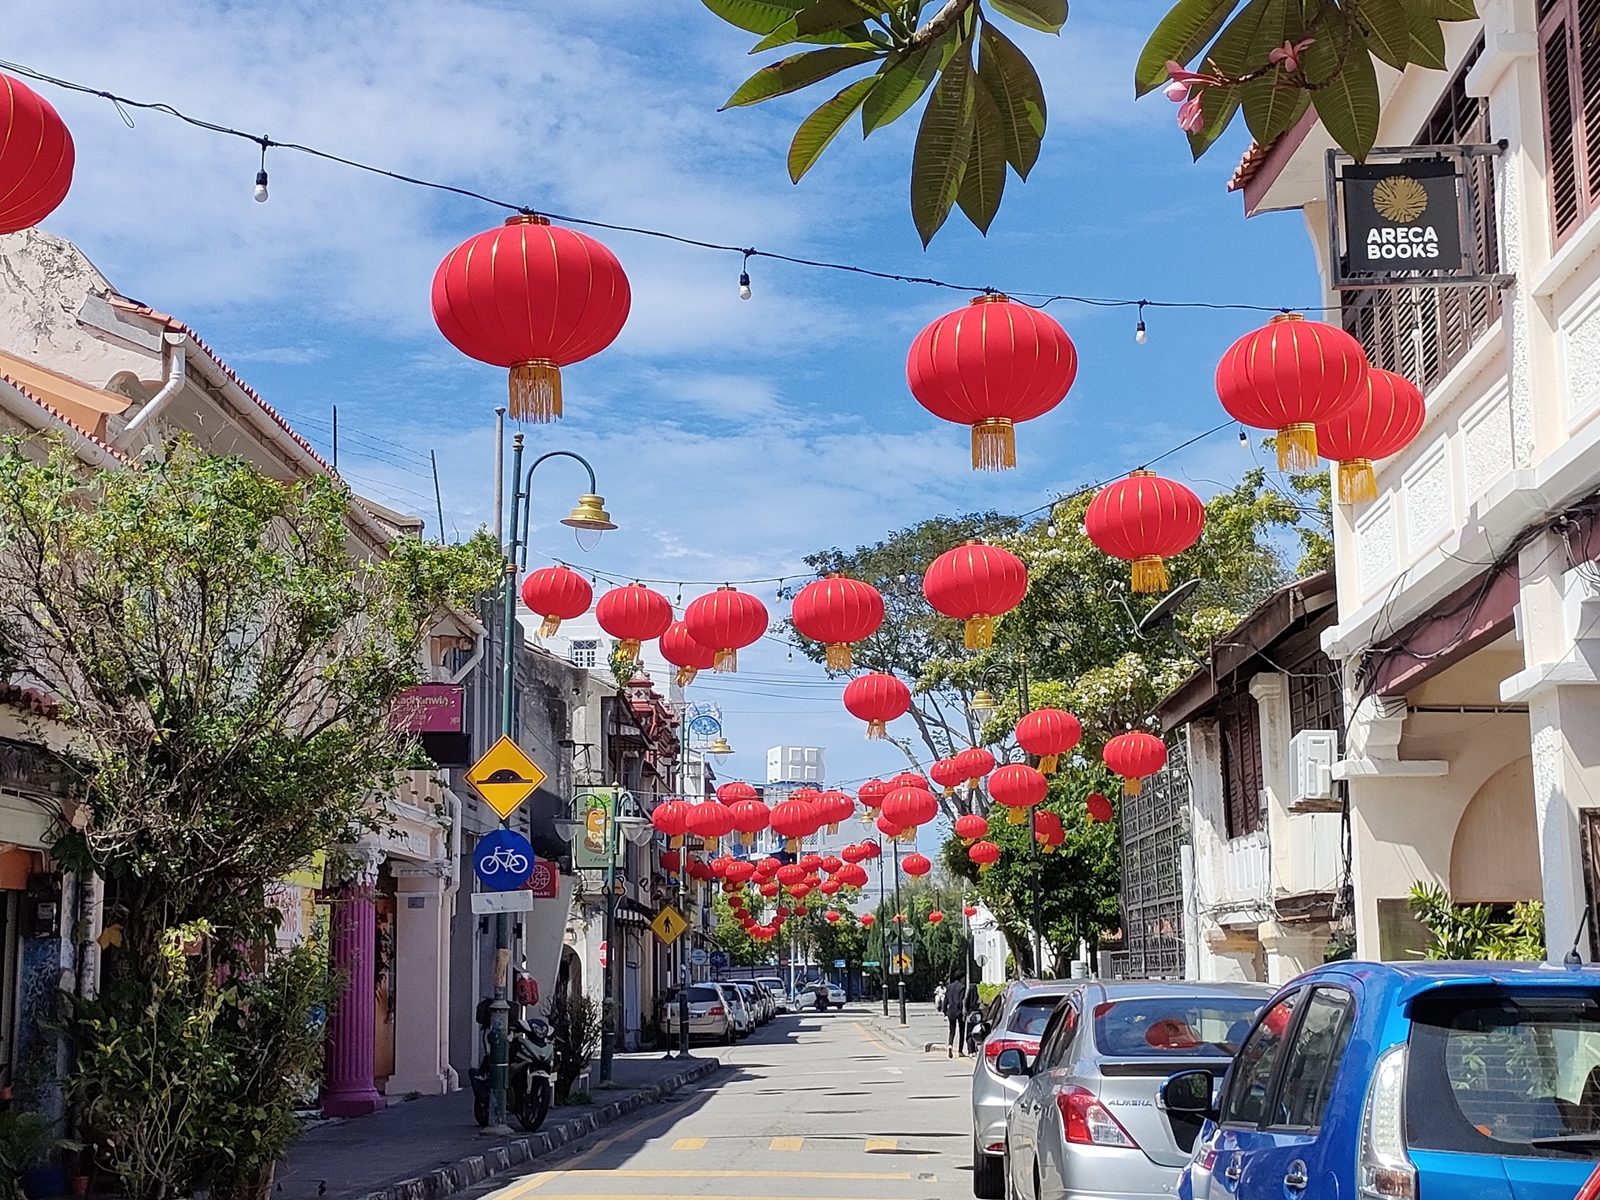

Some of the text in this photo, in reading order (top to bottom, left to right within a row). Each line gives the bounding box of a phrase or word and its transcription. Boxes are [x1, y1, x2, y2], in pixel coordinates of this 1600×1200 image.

[1366, 226, 1438, 244] ARECA
[1367, 243, 1439, 260] BOOKS
[1108, 1099, 1153, 1107] ALMERA
